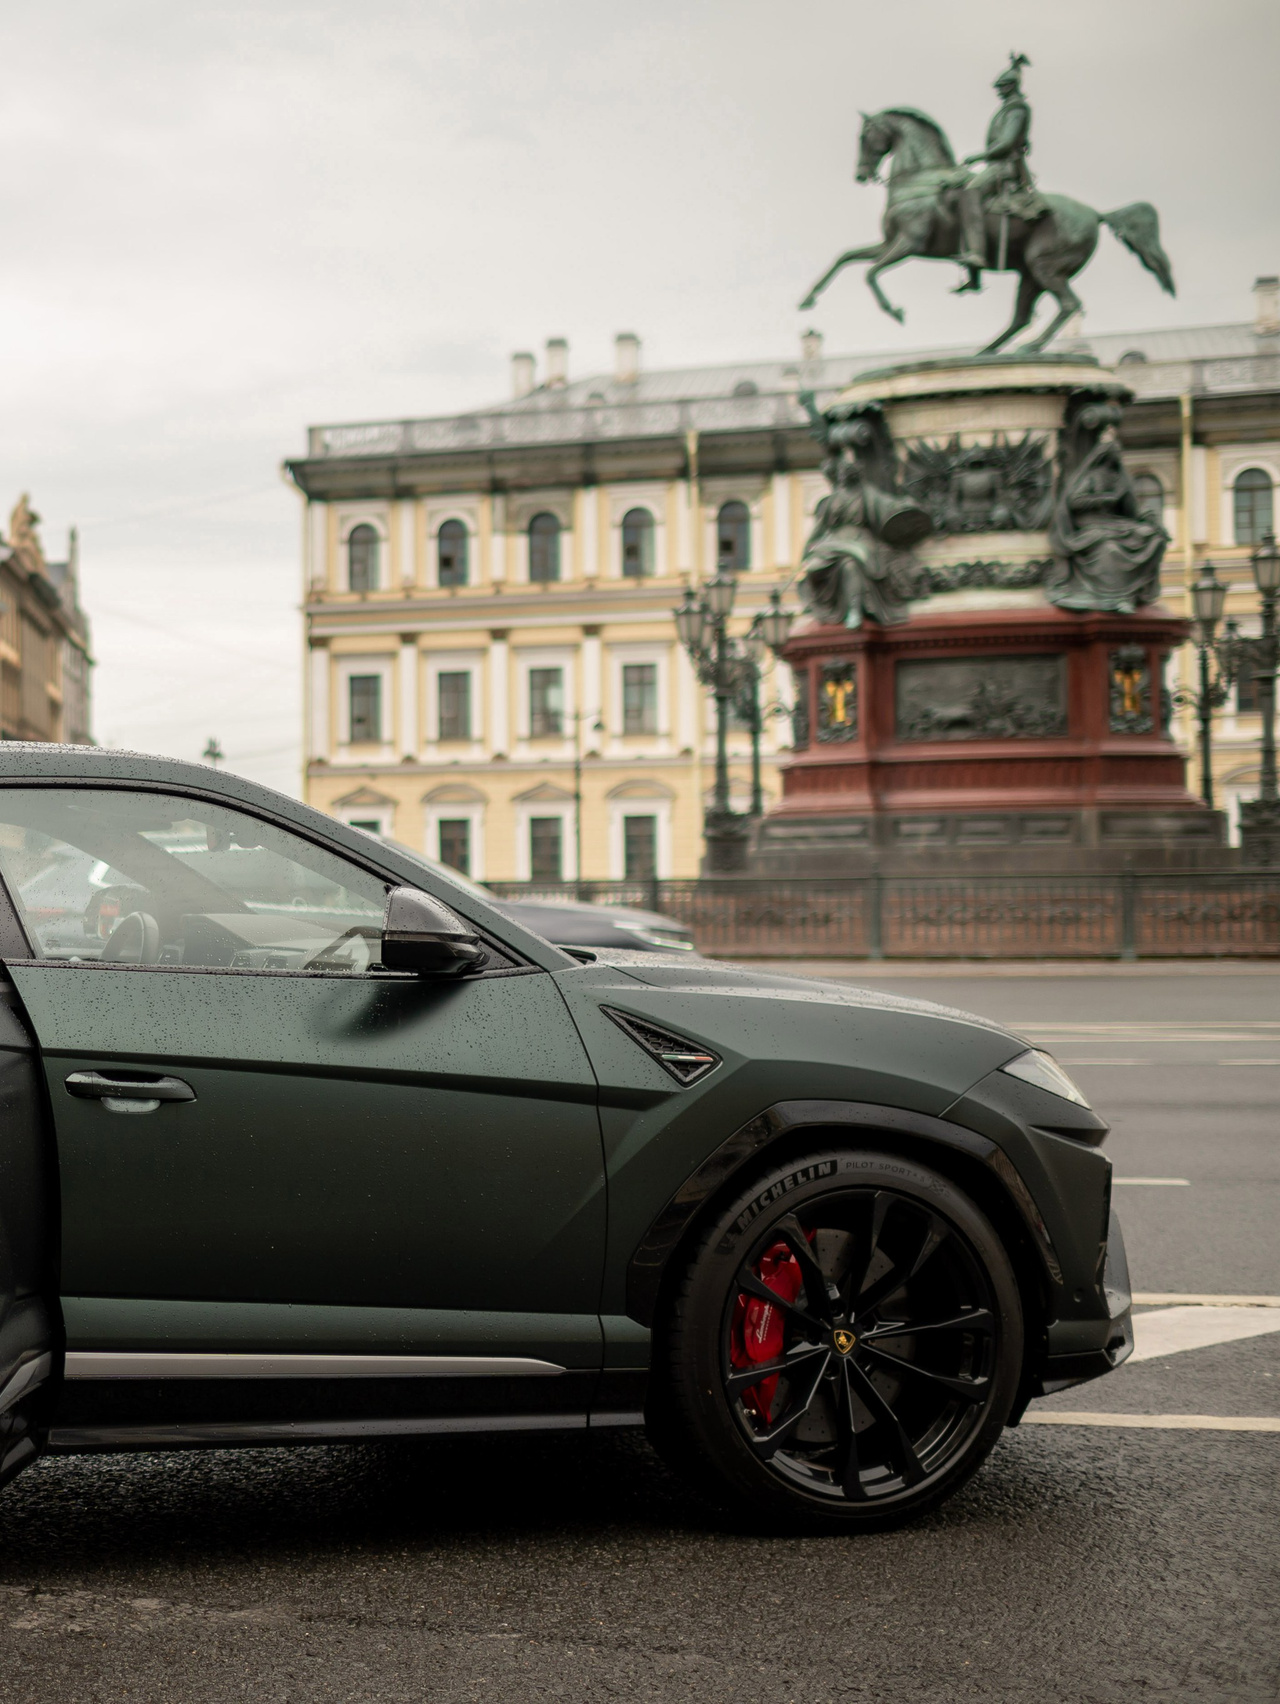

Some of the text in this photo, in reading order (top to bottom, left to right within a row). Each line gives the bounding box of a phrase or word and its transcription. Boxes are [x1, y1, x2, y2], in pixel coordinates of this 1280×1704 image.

[736, 1162, 832, 1230] MICHELIN
[846, 1161, 874, 1169] PILOT
[879, 1163, 912, 1177] SPORT
